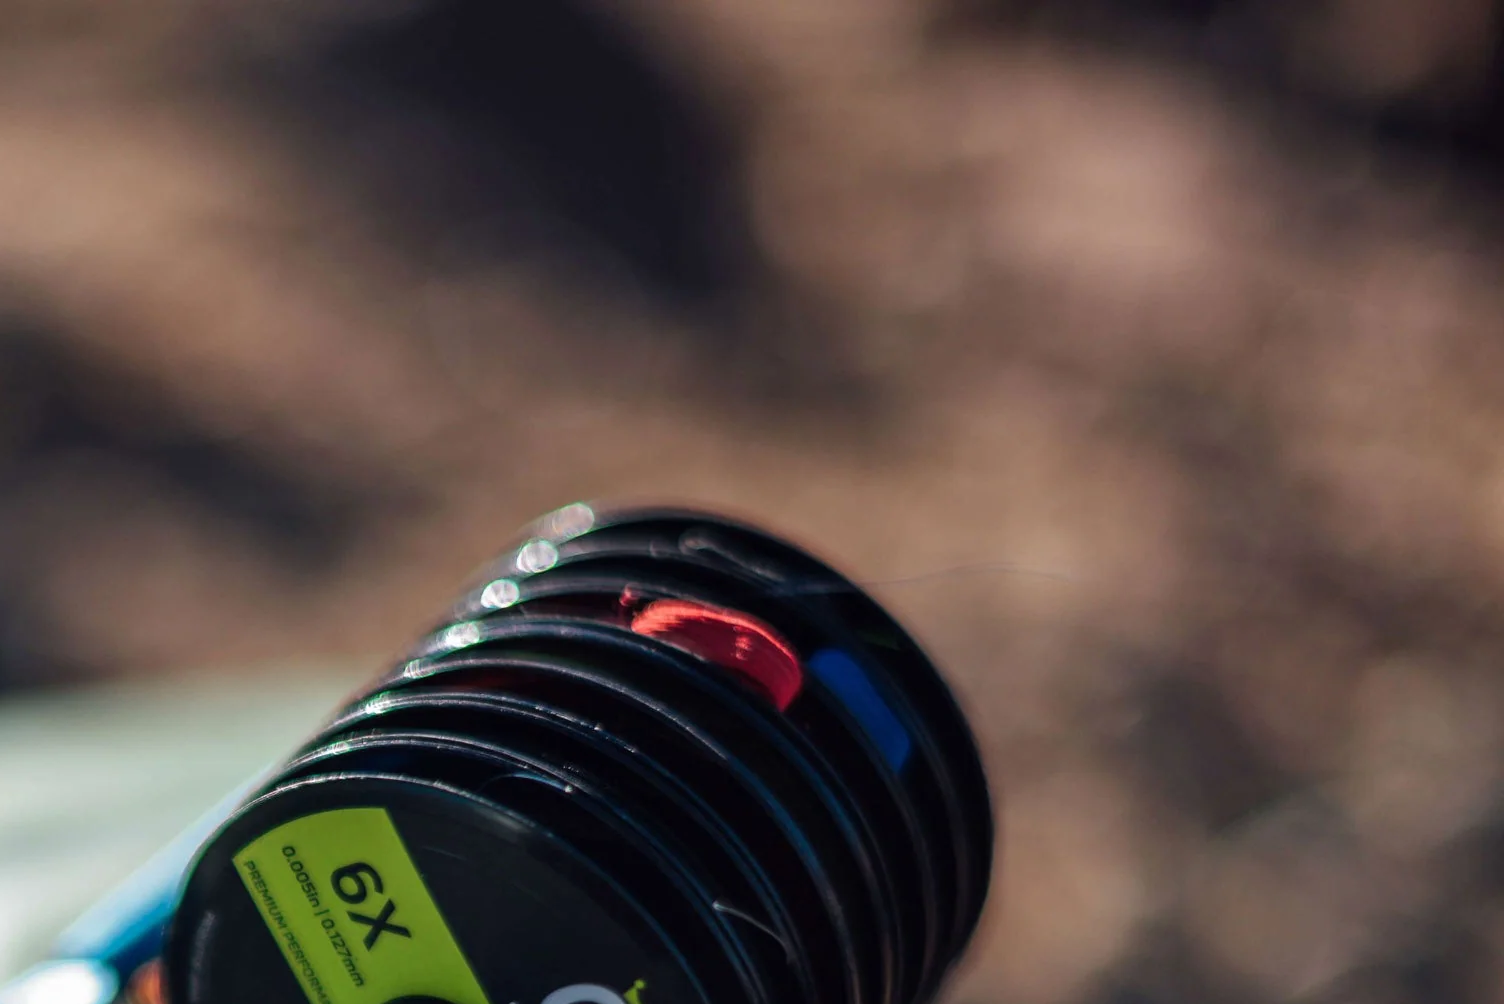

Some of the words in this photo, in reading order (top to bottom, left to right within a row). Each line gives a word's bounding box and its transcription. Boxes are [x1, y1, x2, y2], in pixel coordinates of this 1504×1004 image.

[244, 861, 287, 929] PREMIUM
[282, 846, 320, 908] 0.005in
[321, 919, 364, 987] 0.127mm
[331, 862, 411, 951] 6X
